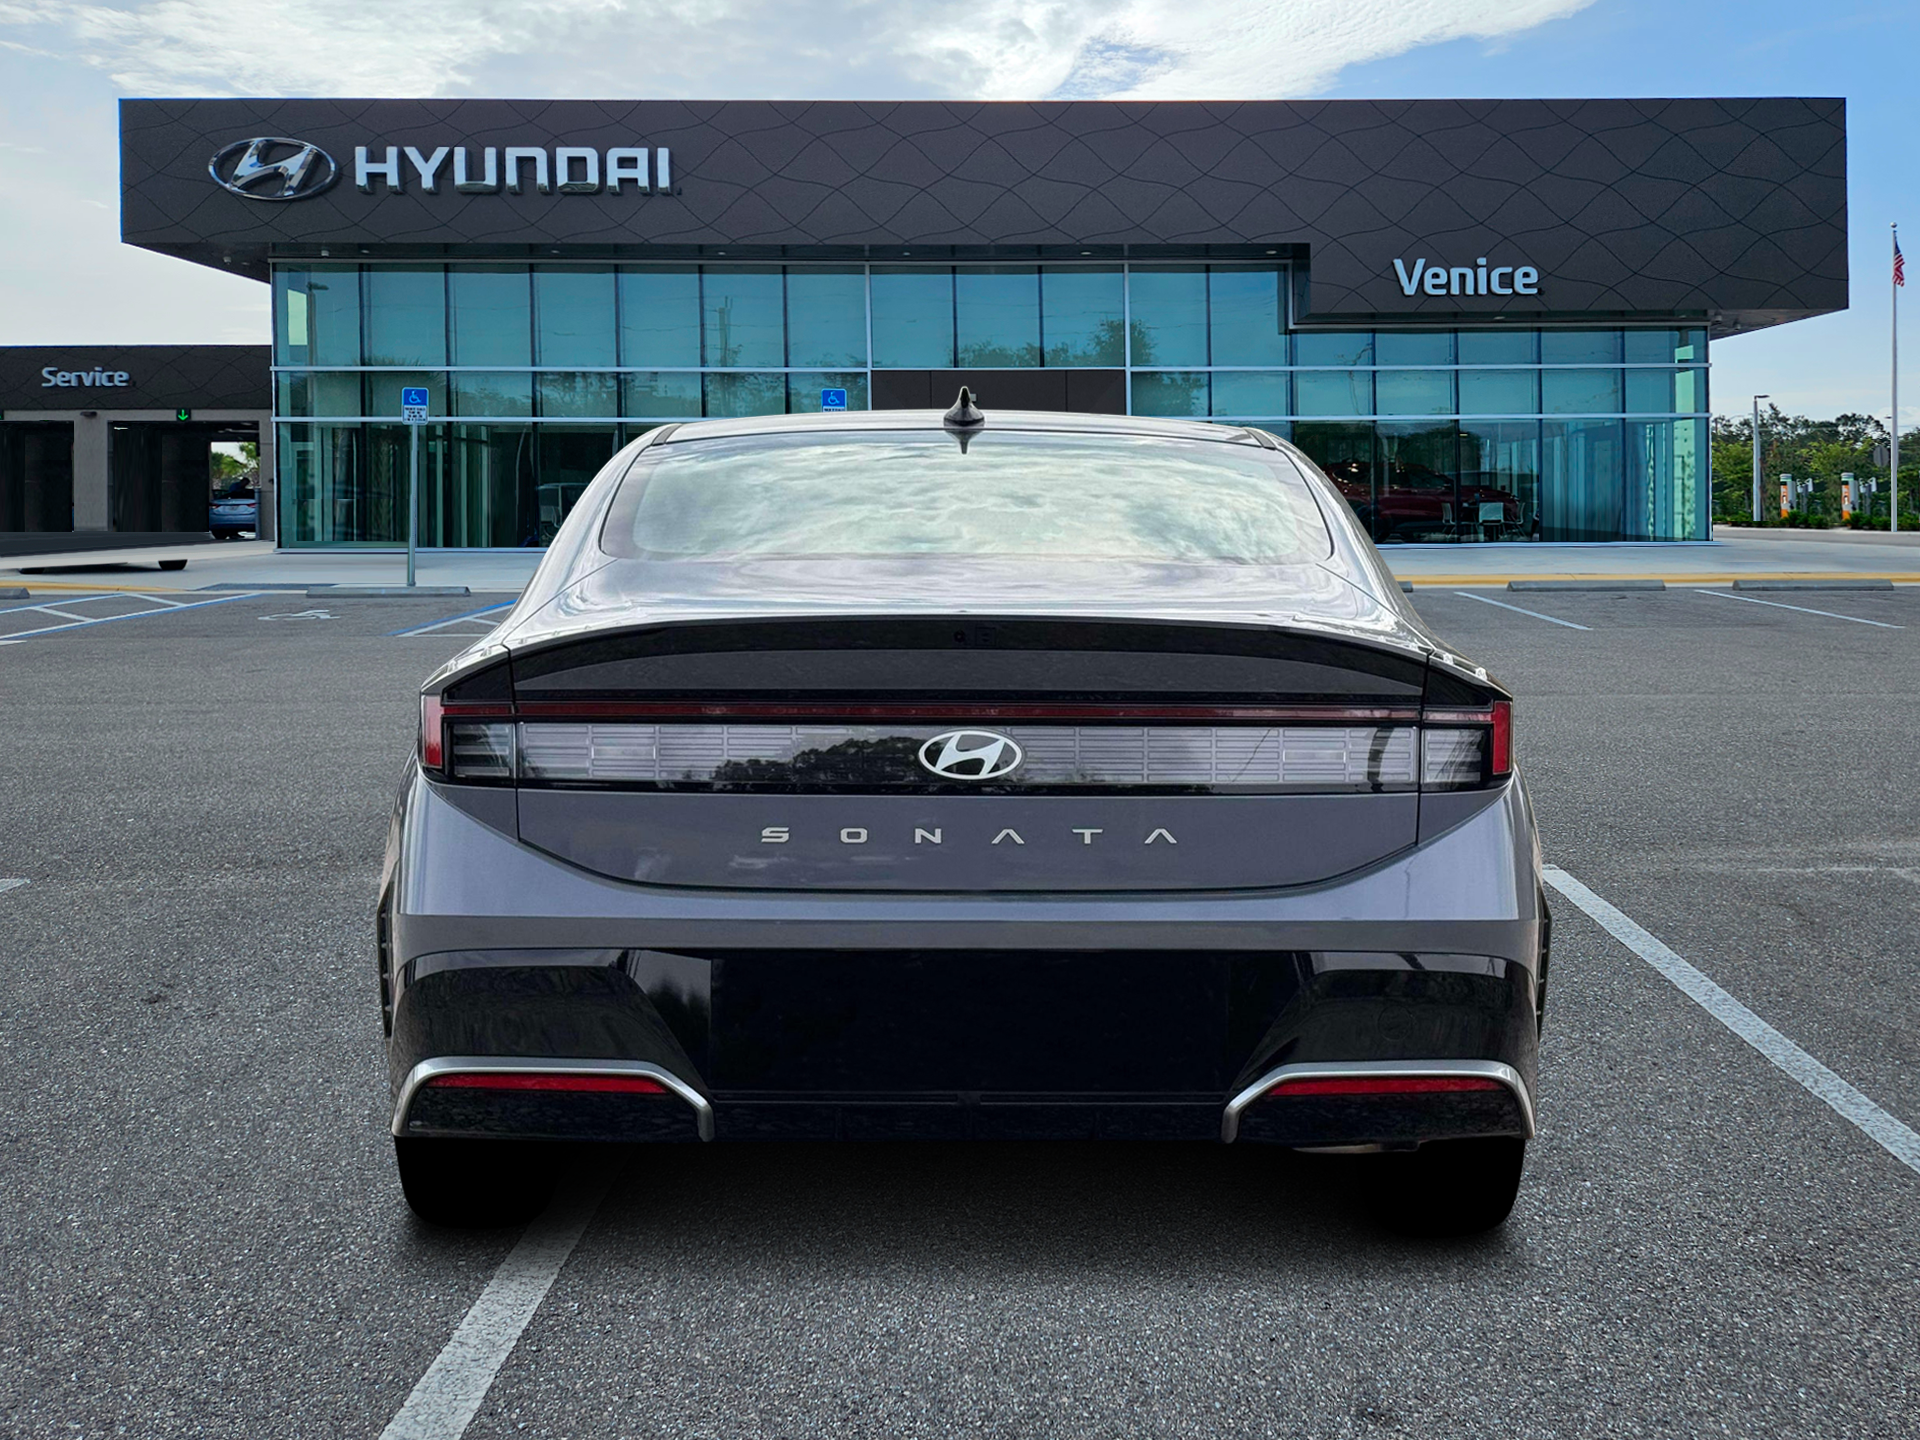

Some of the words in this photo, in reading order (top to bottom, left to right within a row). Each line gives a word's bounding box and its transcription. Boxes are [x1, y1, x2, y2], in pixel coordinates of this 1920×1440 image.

[355, 146, 672, 194] HYUNDAI
[1393, 257, 1539, 296] Venice
[41, 366, 130, 387] Service
[761, 826, 1178, 845] SONATA
